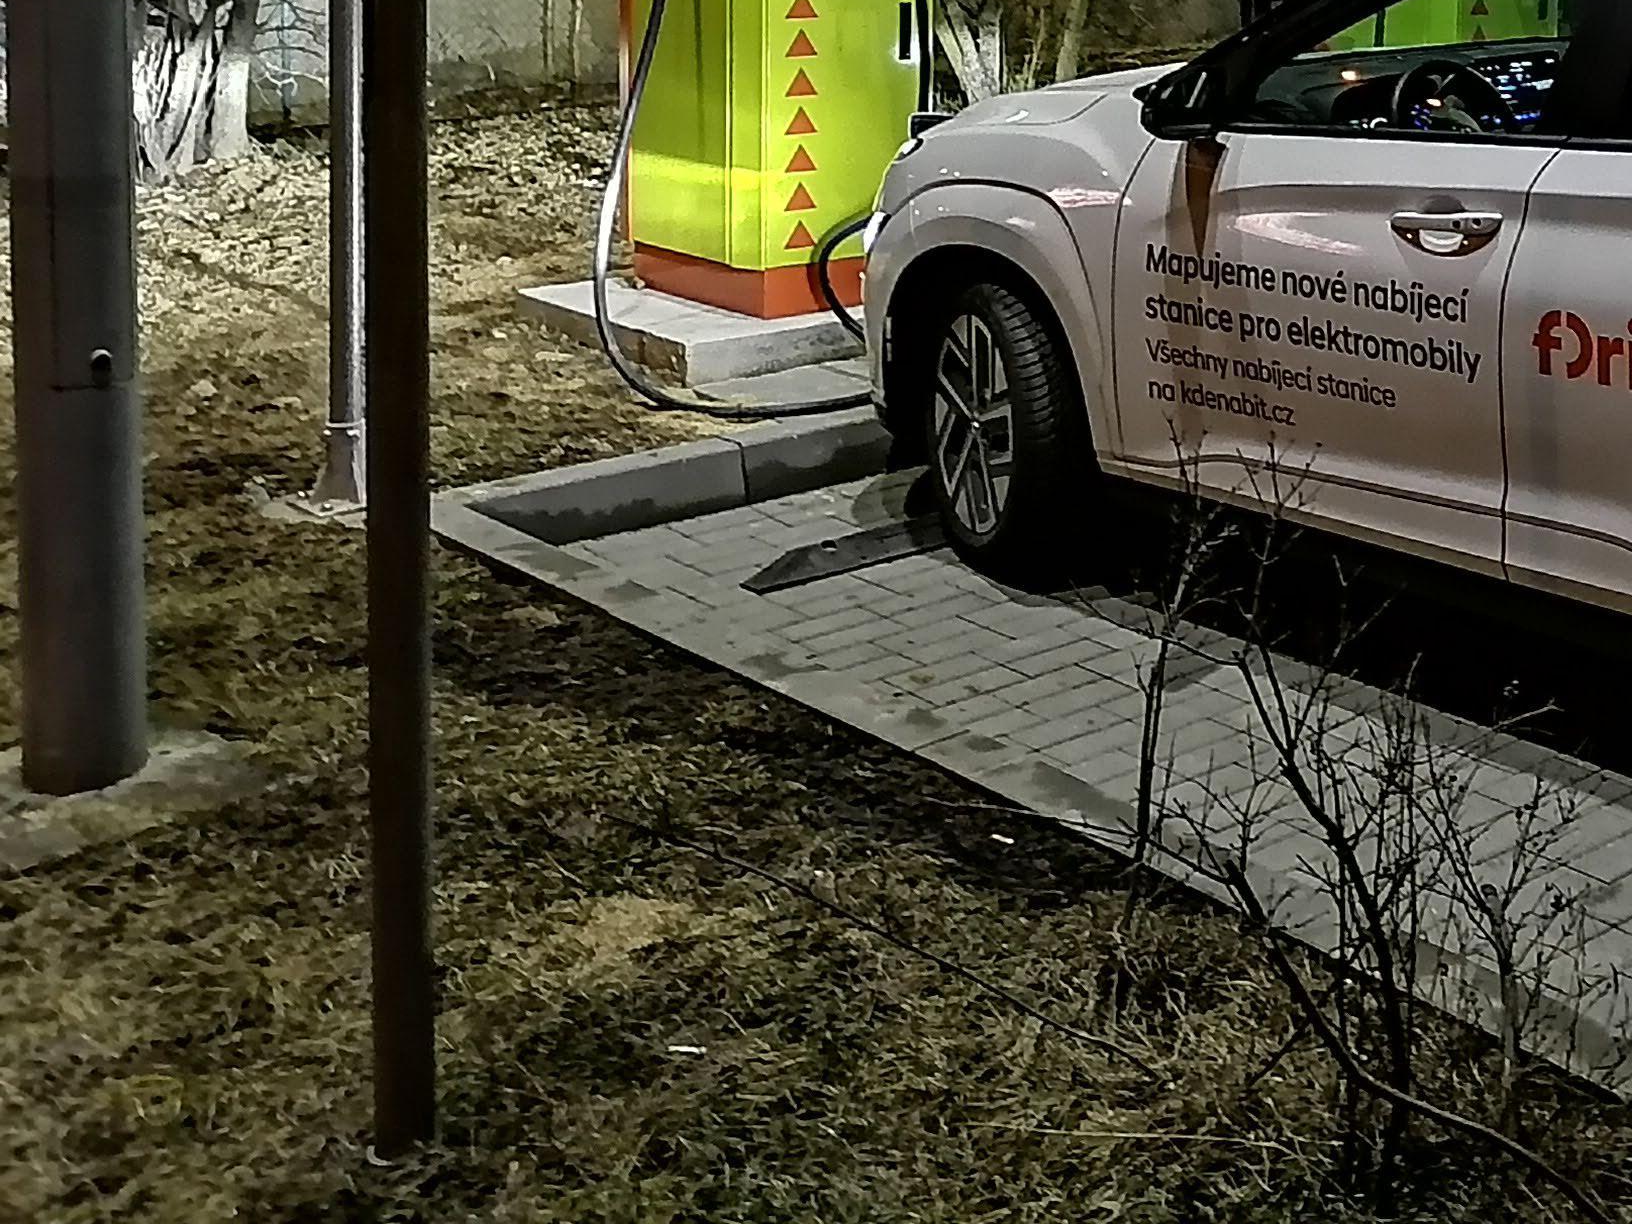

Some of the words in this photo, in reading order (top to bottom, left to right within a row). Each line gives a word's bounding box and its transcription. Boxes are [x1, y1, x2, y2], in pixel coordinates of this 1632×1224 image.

[1146, 243, 1276, 292] Mapujeme
[1282, 270, 1347, 303] nové
[1353, 279, 1470, 323] nabíjecí
[1145, 295, 1233, 332] stanice
[1239, 313, 1281, 342] pro
[1287, 316, 1481, 383] elektromobily
[1145, 337, 1228, 379] Všechny
[1233, 360, 1313, 391] nabíjecí
[1317, 373, 1396, 408] stanice
[1148, 378, 1175, 402] na
[1180, 380, 1297, 426] kdenabit.cz
